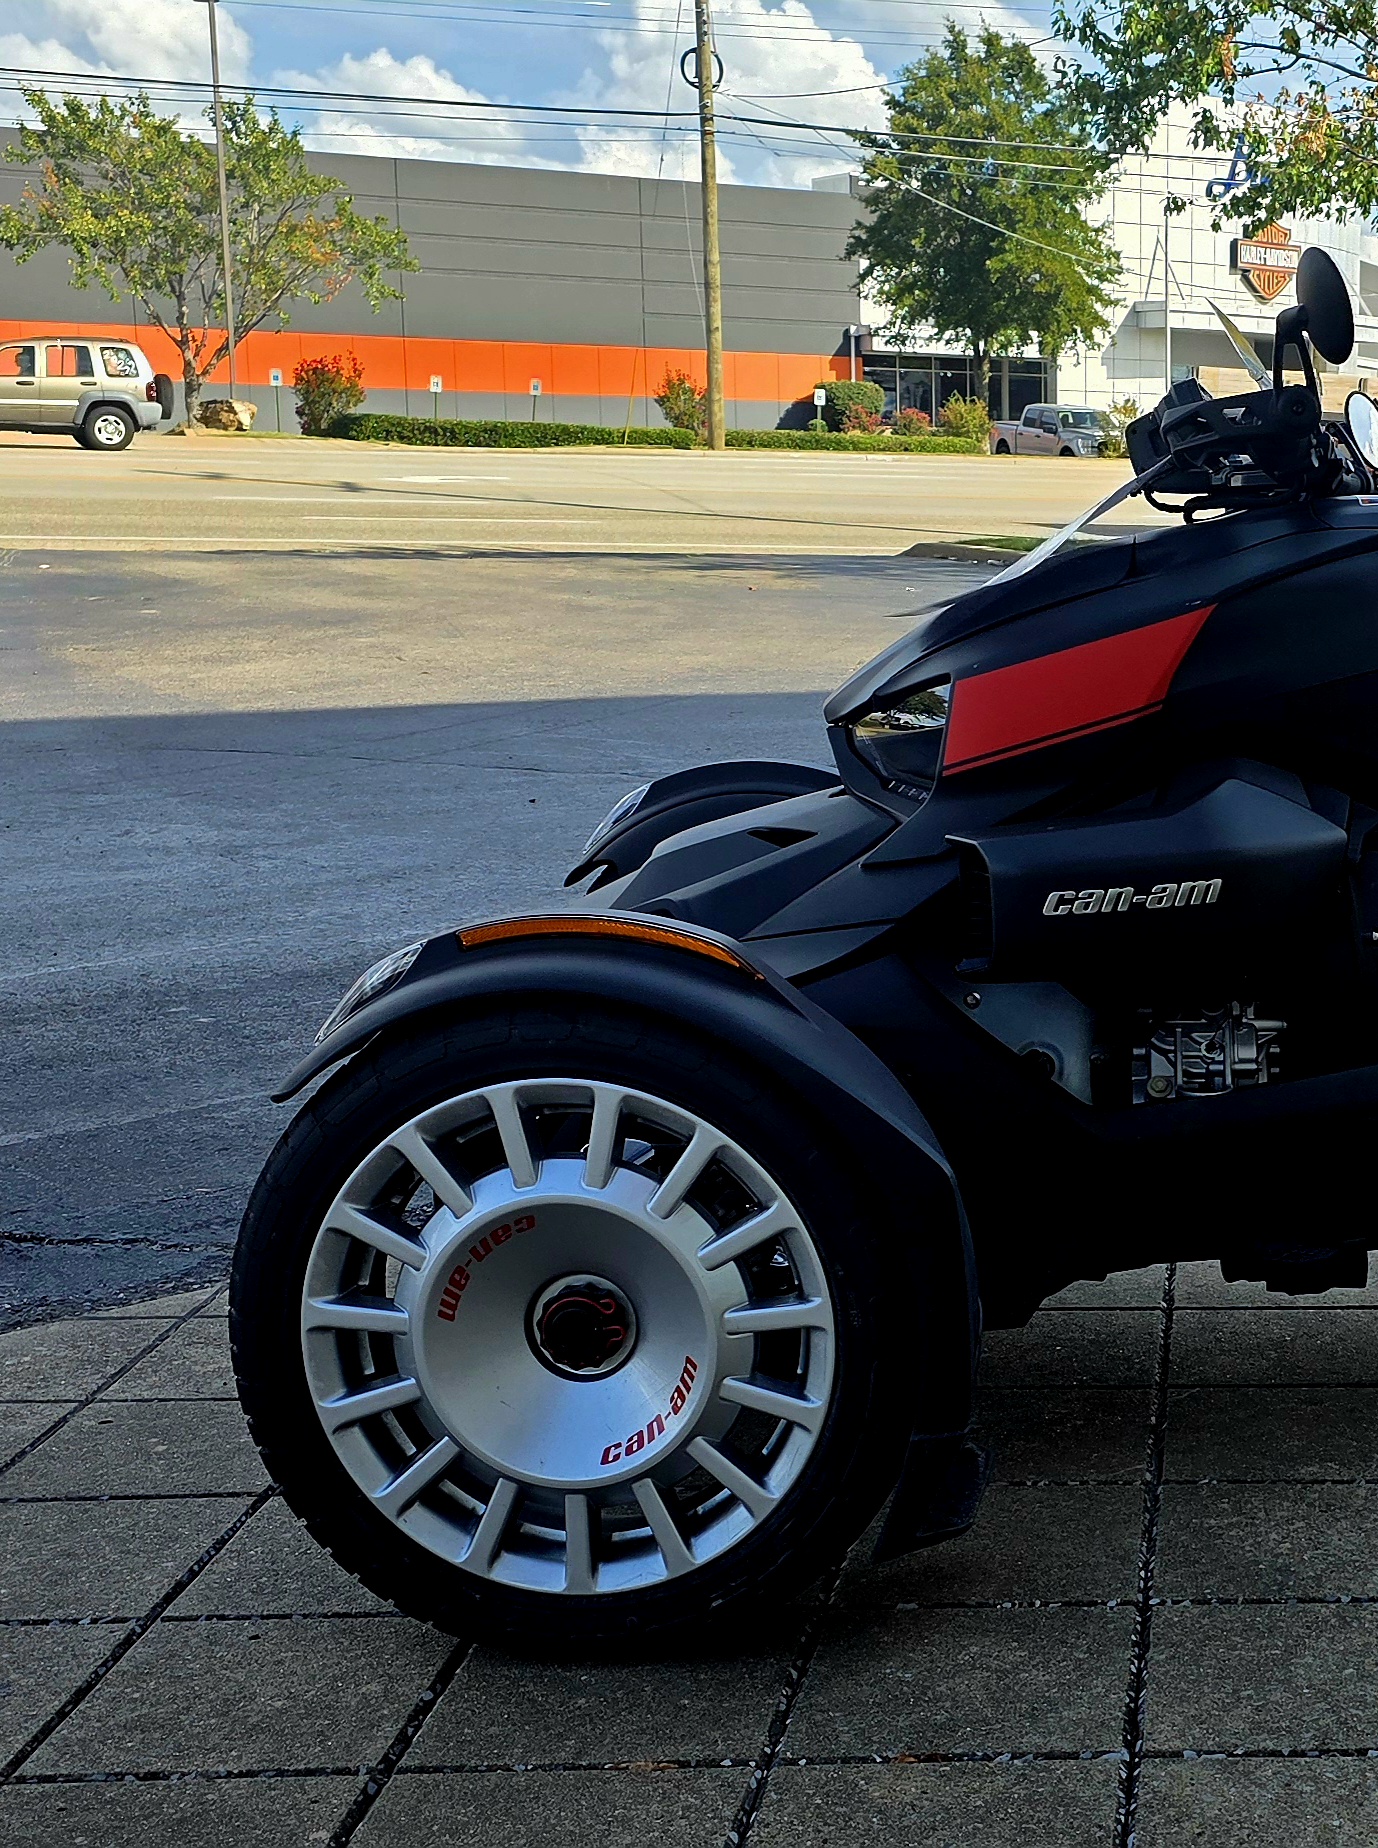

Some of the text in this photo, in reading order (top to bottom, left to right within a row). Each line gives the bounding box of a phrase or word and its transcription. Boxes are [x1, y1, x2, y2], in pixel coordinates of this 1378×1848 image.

[1253, 270, 1286, 294] CYCLES
[1042, 878, 1223, 916] can-am
[436, 1214, 537, 1323] can-am
[599, 1354, 699, 1466] can-am
